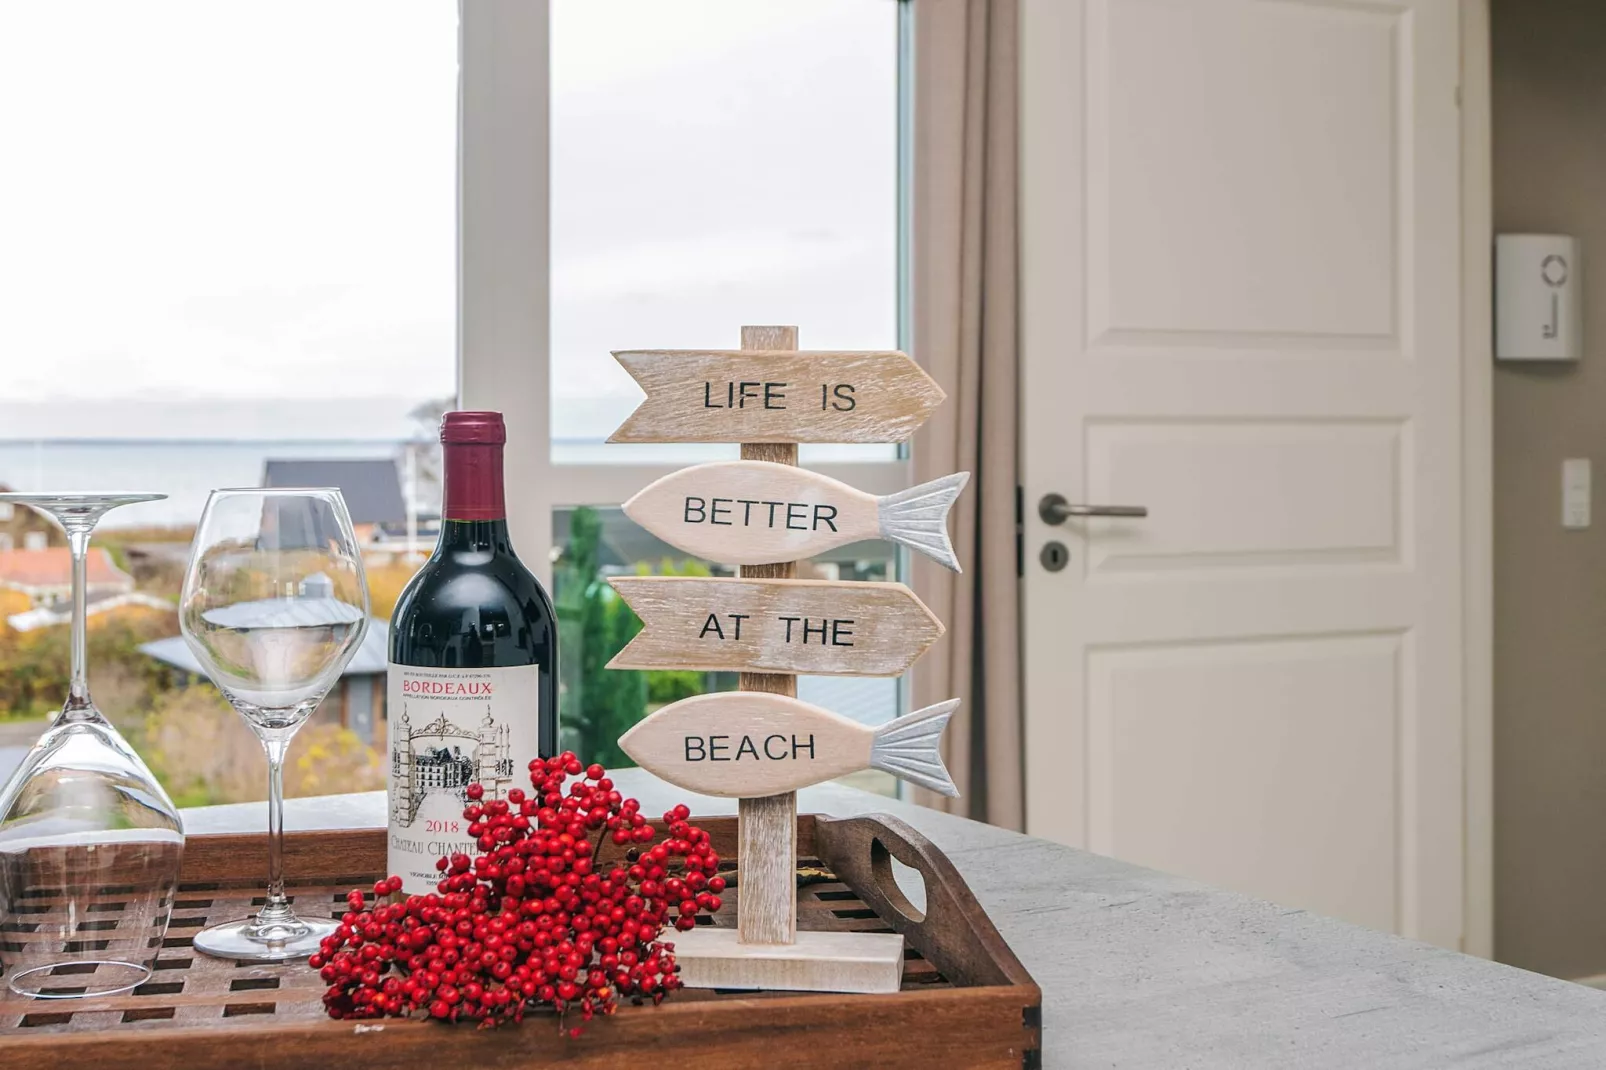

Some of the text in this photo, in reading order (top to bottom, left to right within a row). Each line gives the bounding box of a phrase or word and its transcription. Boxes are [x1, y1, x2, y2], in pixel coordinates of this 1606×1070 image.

[704, 381, 856, 412] LIFE IS
[683, 496, 838, 533] BETTER
[699, 613, 855, 647] AT THE
[403, 680, 492, 694] BORDEAUX
[684, 733, 815, 761] BEACH
[425, 820, 459, 833] 2018
[391, 835, 424, 854] CHATEAU
